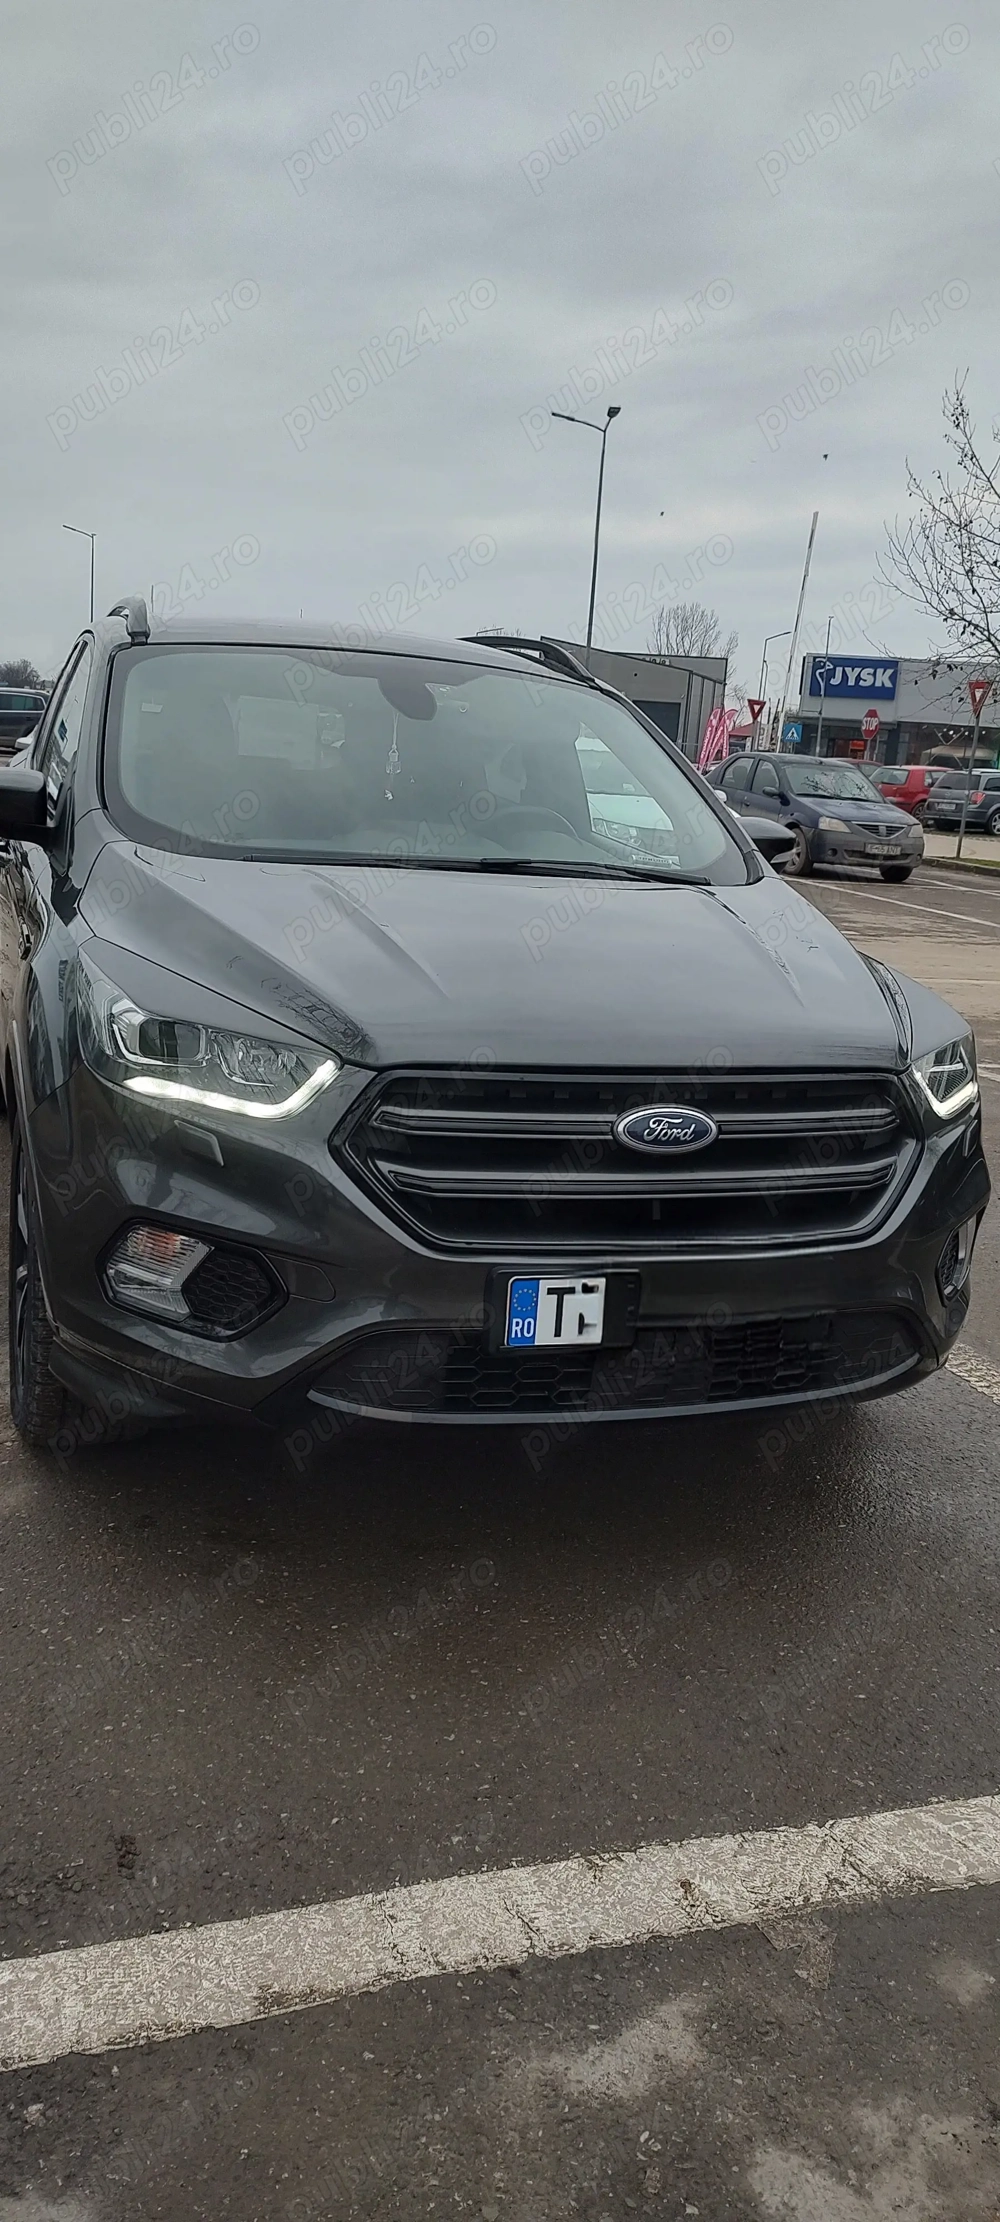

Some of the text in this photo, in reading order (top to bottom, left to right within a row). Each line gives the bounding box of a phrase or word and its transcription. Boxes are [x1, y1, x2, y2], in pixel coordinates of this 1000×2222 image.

[829, 666, 895, 688] JYSK
[861, 717, 879, 731] STOP
[643, 1116, 696, 1141] Ford
[511, 1317, 535, 1338] RO
